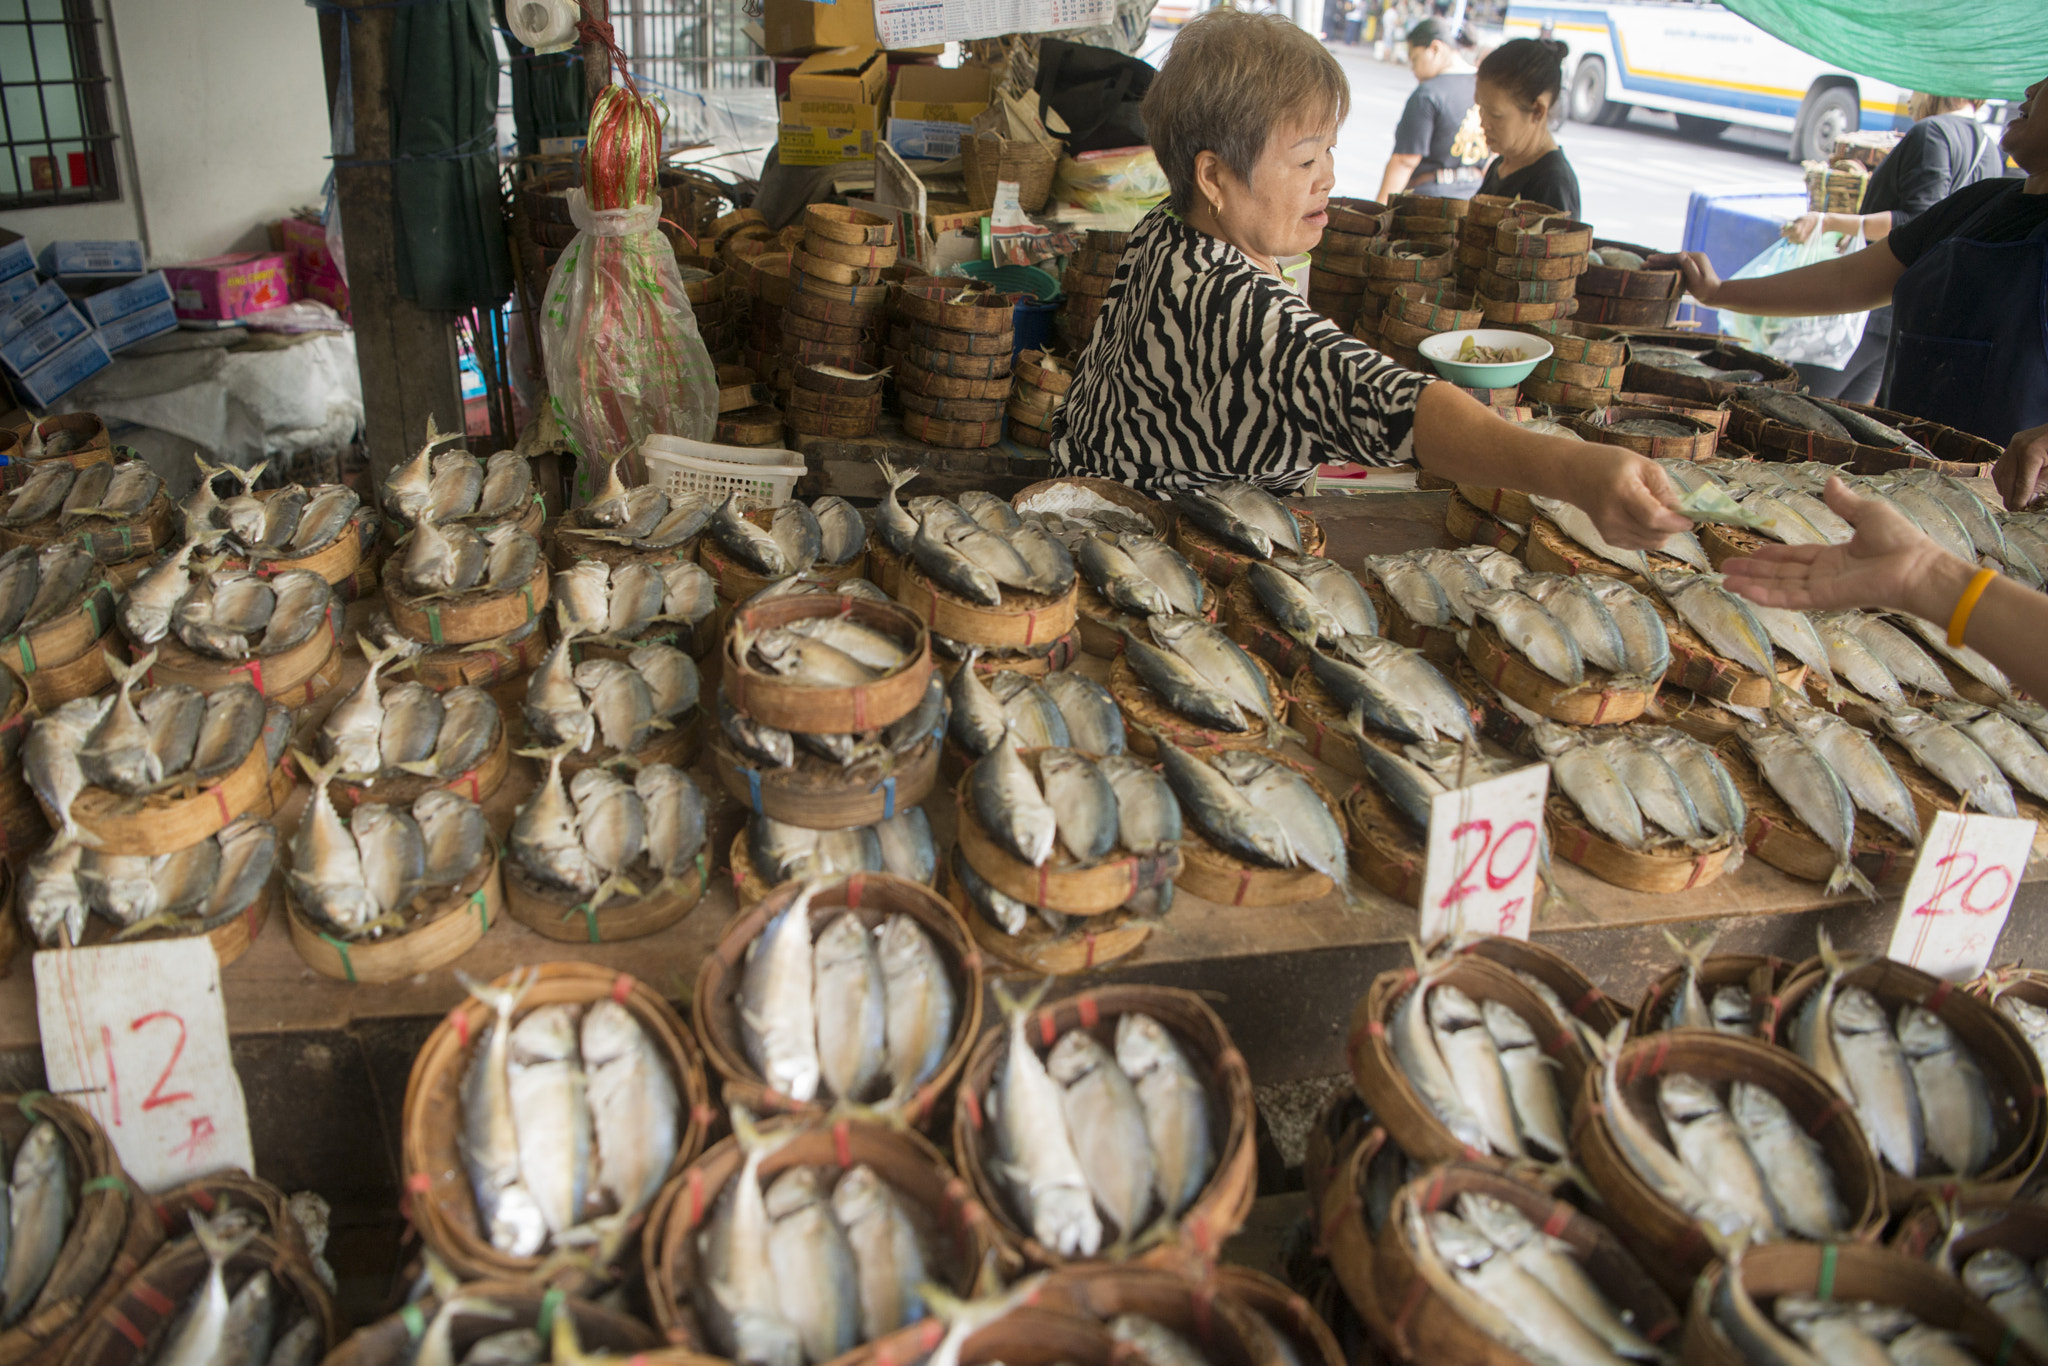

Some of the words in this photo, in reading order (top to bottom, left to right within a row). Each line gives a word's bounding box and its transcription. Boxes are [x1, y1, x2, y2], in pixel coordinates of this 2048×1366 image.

[1440, 819, 1538, 909] 20
[1912, 851, 2014, 917] 20
[101, 1010, 195, 1128] 12
